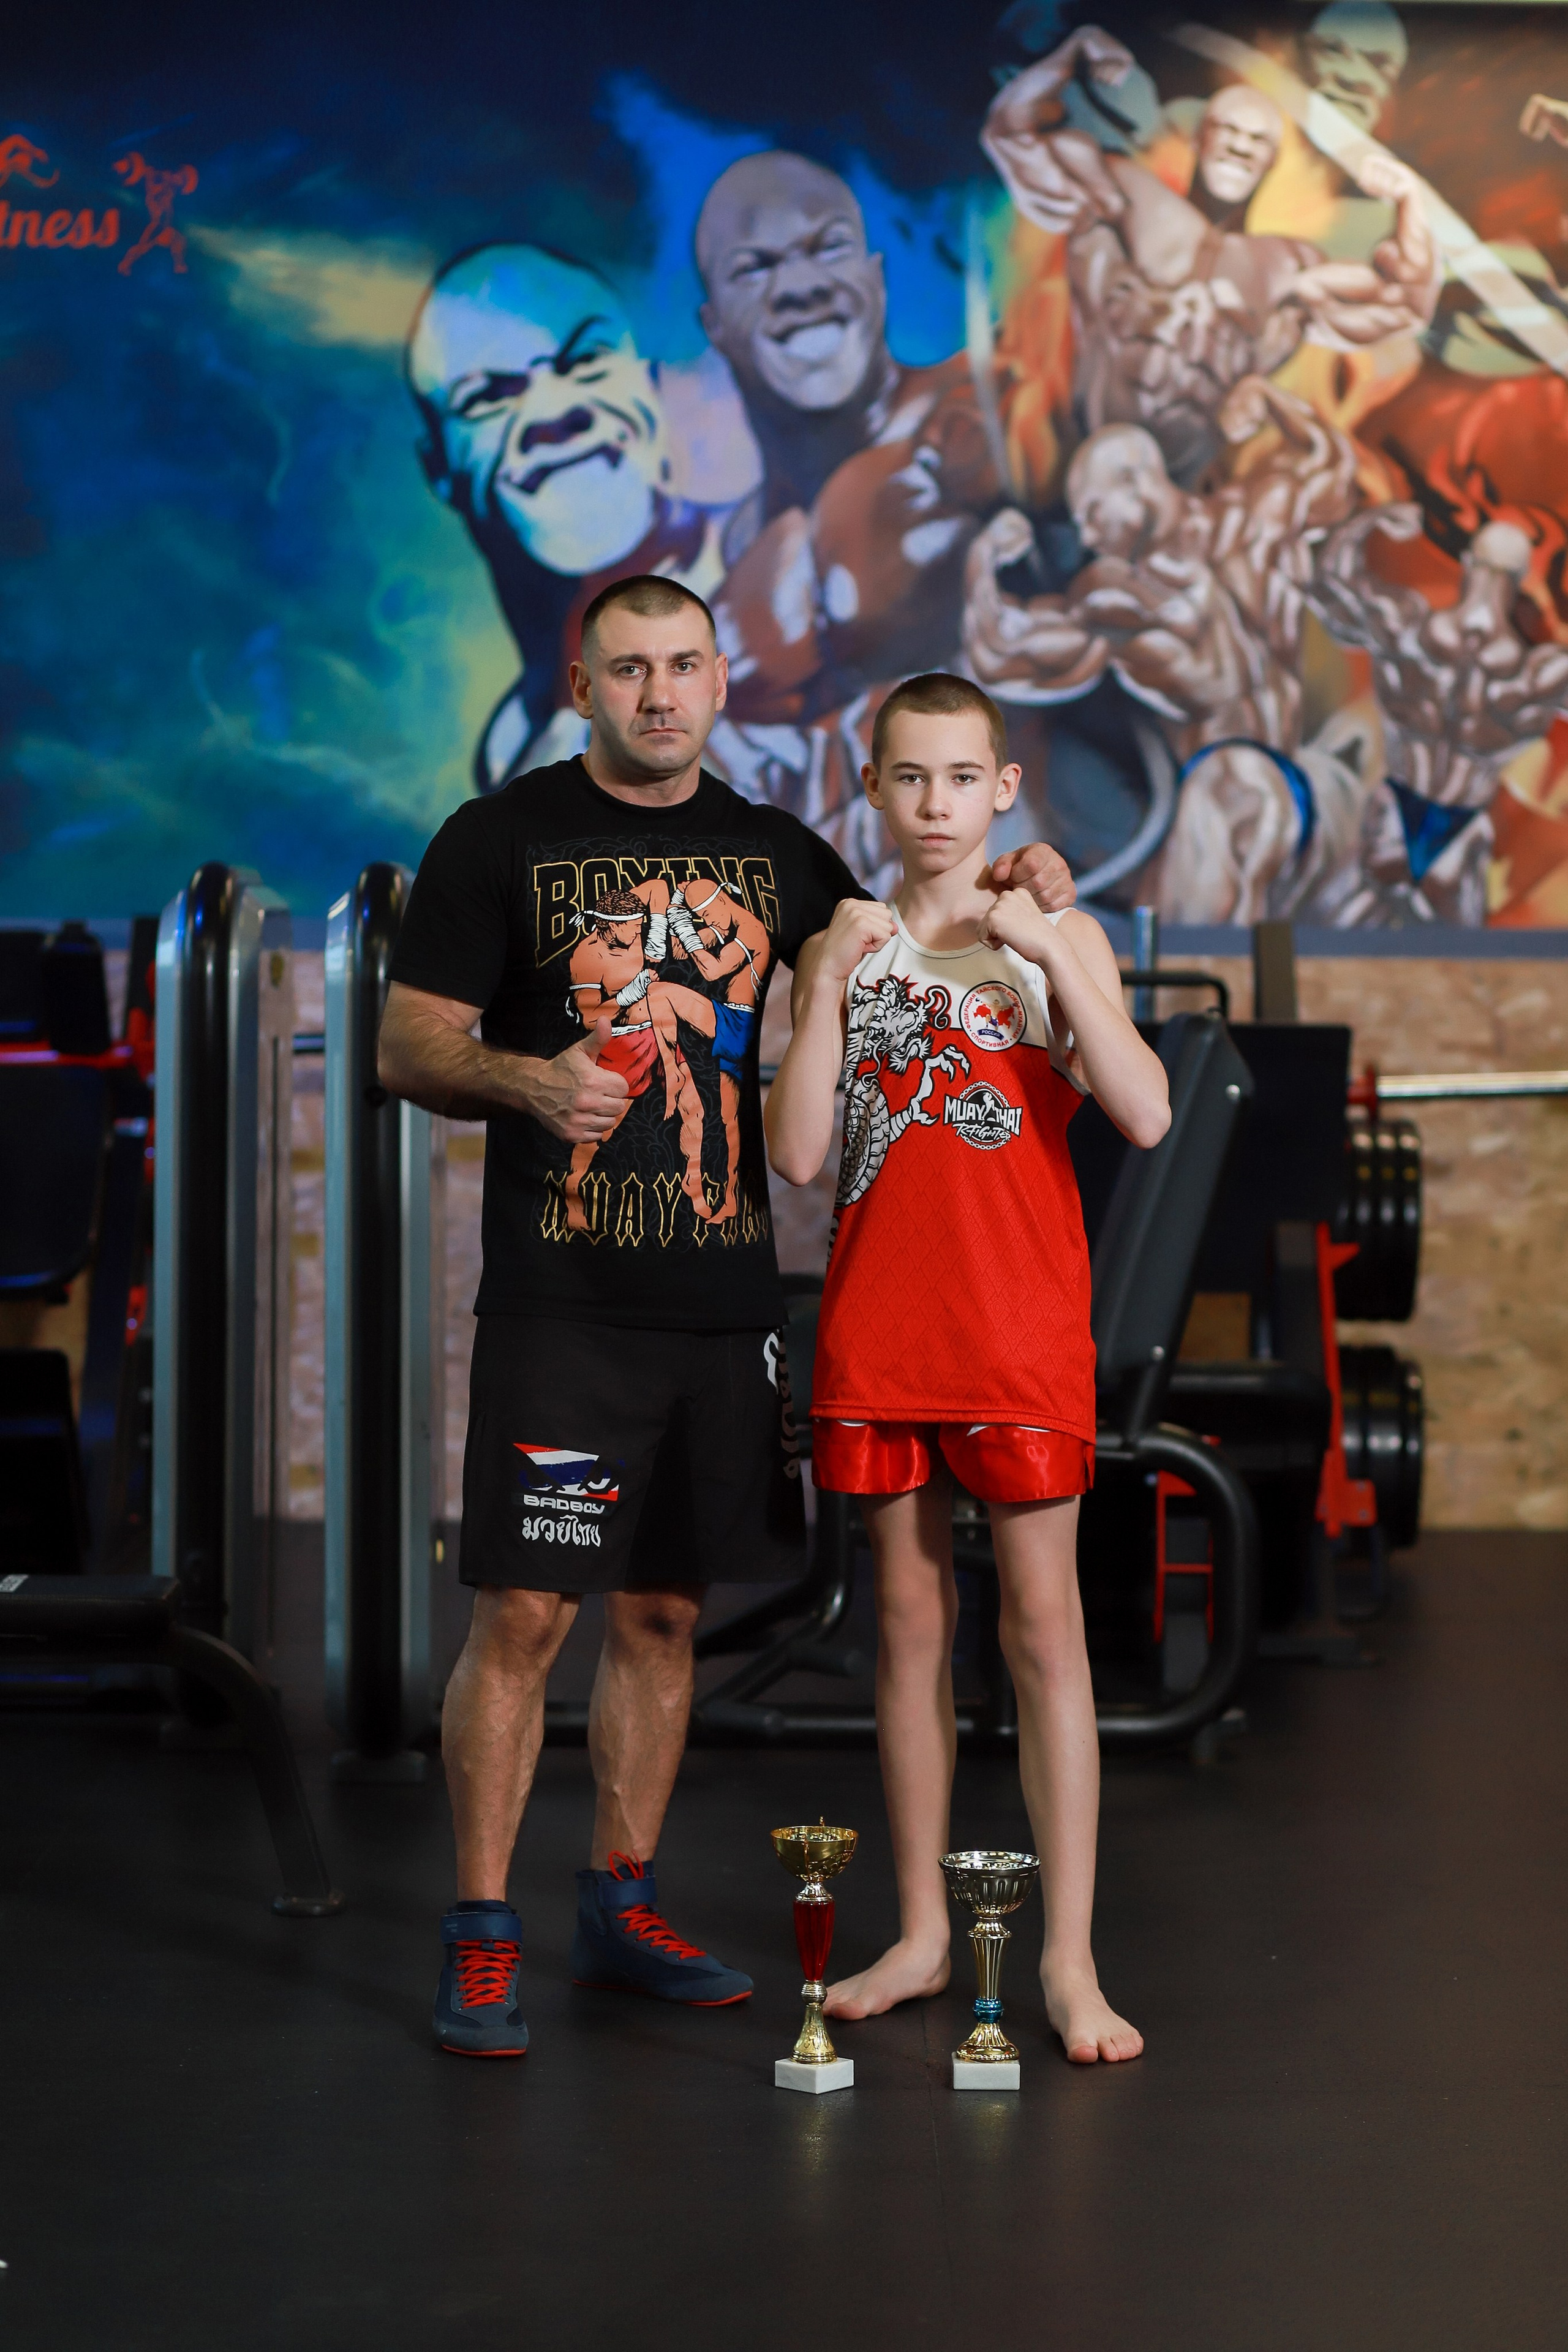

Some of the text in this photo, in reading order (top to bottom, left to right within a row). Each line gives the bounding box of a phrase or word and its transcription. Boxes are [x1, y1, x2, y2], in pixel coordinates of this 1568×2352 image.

[964, 993, 976, 1029] ФЕДЕРАЦИЯ
[971, 1032, 1009, 1047] СПОРТИВНАЯ
[981, 1030, 1001, 1038] РОССИЯ
[944, 1096, 1022, 1136] MUAY THAI
[523, 1494, 605, 1514] BADBOY
[522, 1514, 601, 1547] มวยไทย
